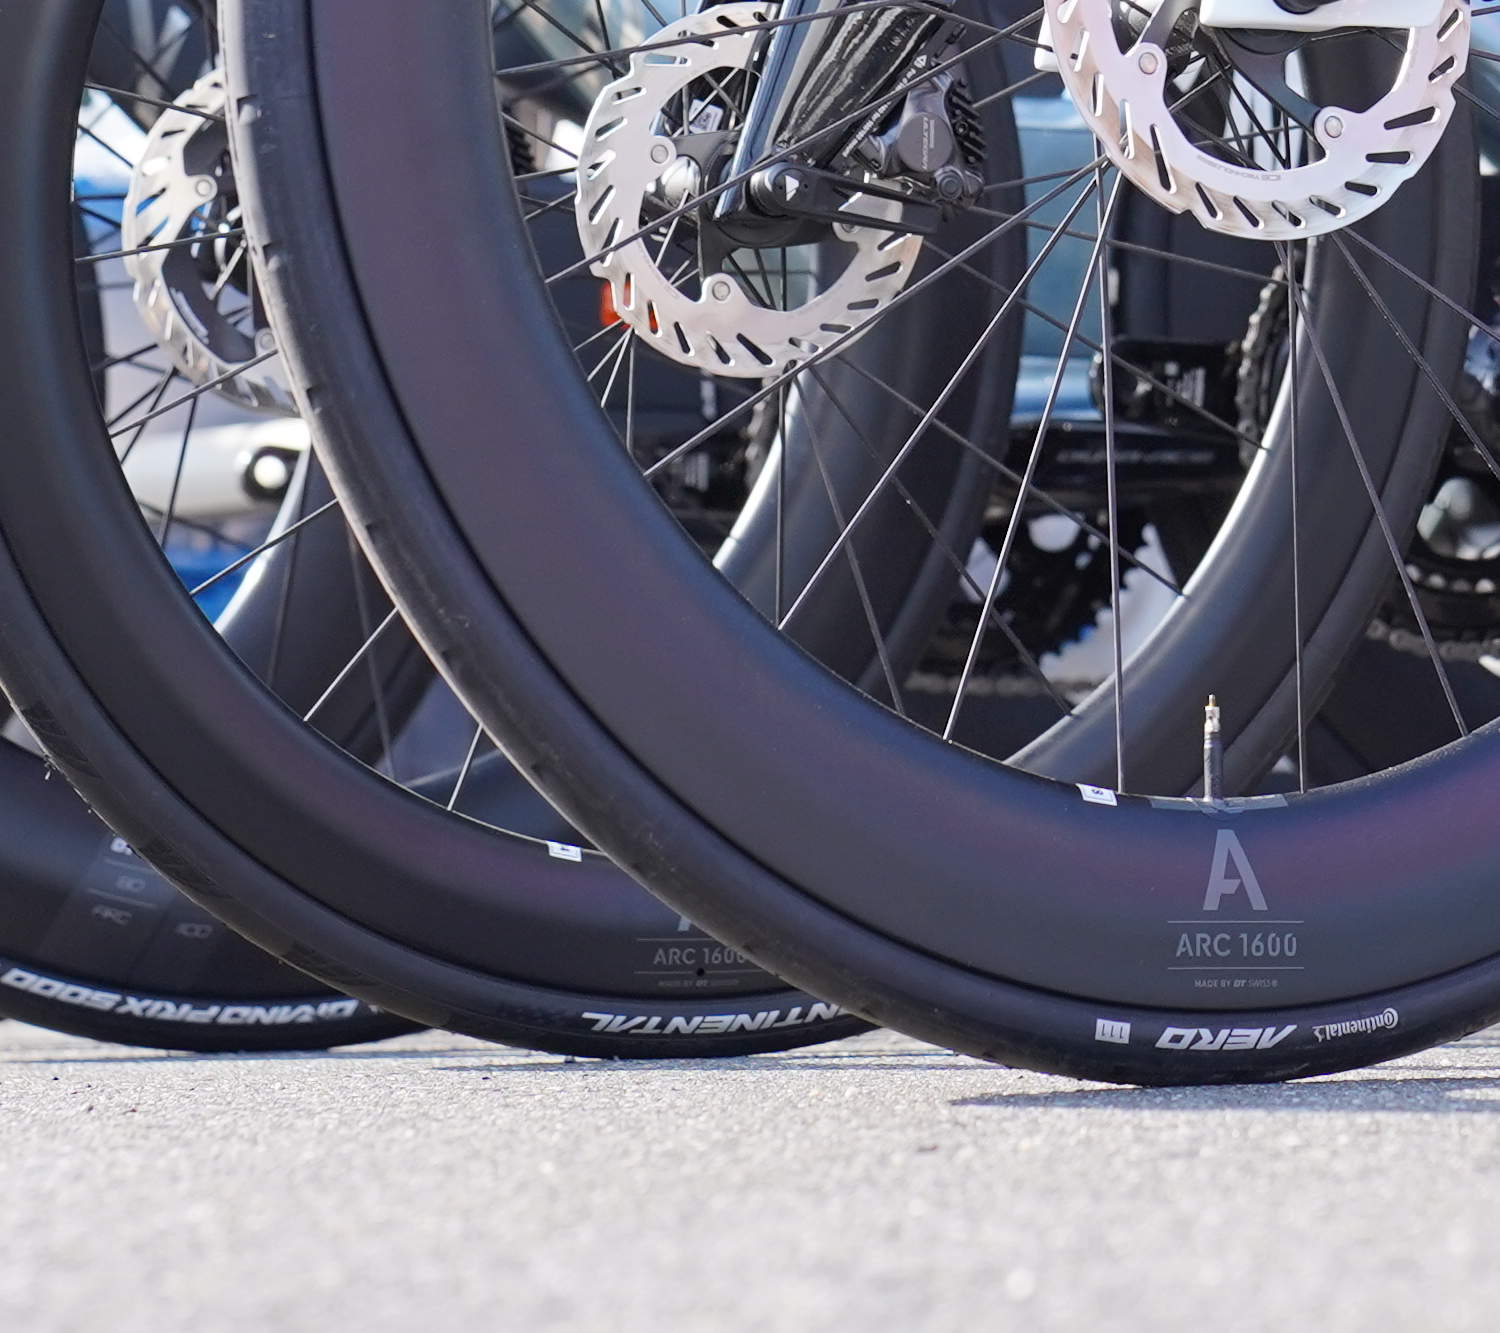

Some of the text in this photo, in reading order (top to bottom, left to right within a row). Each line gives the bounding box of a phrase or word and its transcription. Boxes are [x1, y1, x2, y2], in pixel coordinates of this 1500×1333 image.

[1203, 828, 1269, 911] A
[653, 947, 696, 966] ARC
[1175, 932, 1298, 958] ARC 1600
[1, 967, 122, 1011] 5000
[1233, 979, 1247, 988] DT
[581, 1001, 856, 1035] NTINENTAL
[1325, 1007, 1399, 1041] Continental
[1155, 1024, 1298, 1051] AERO
